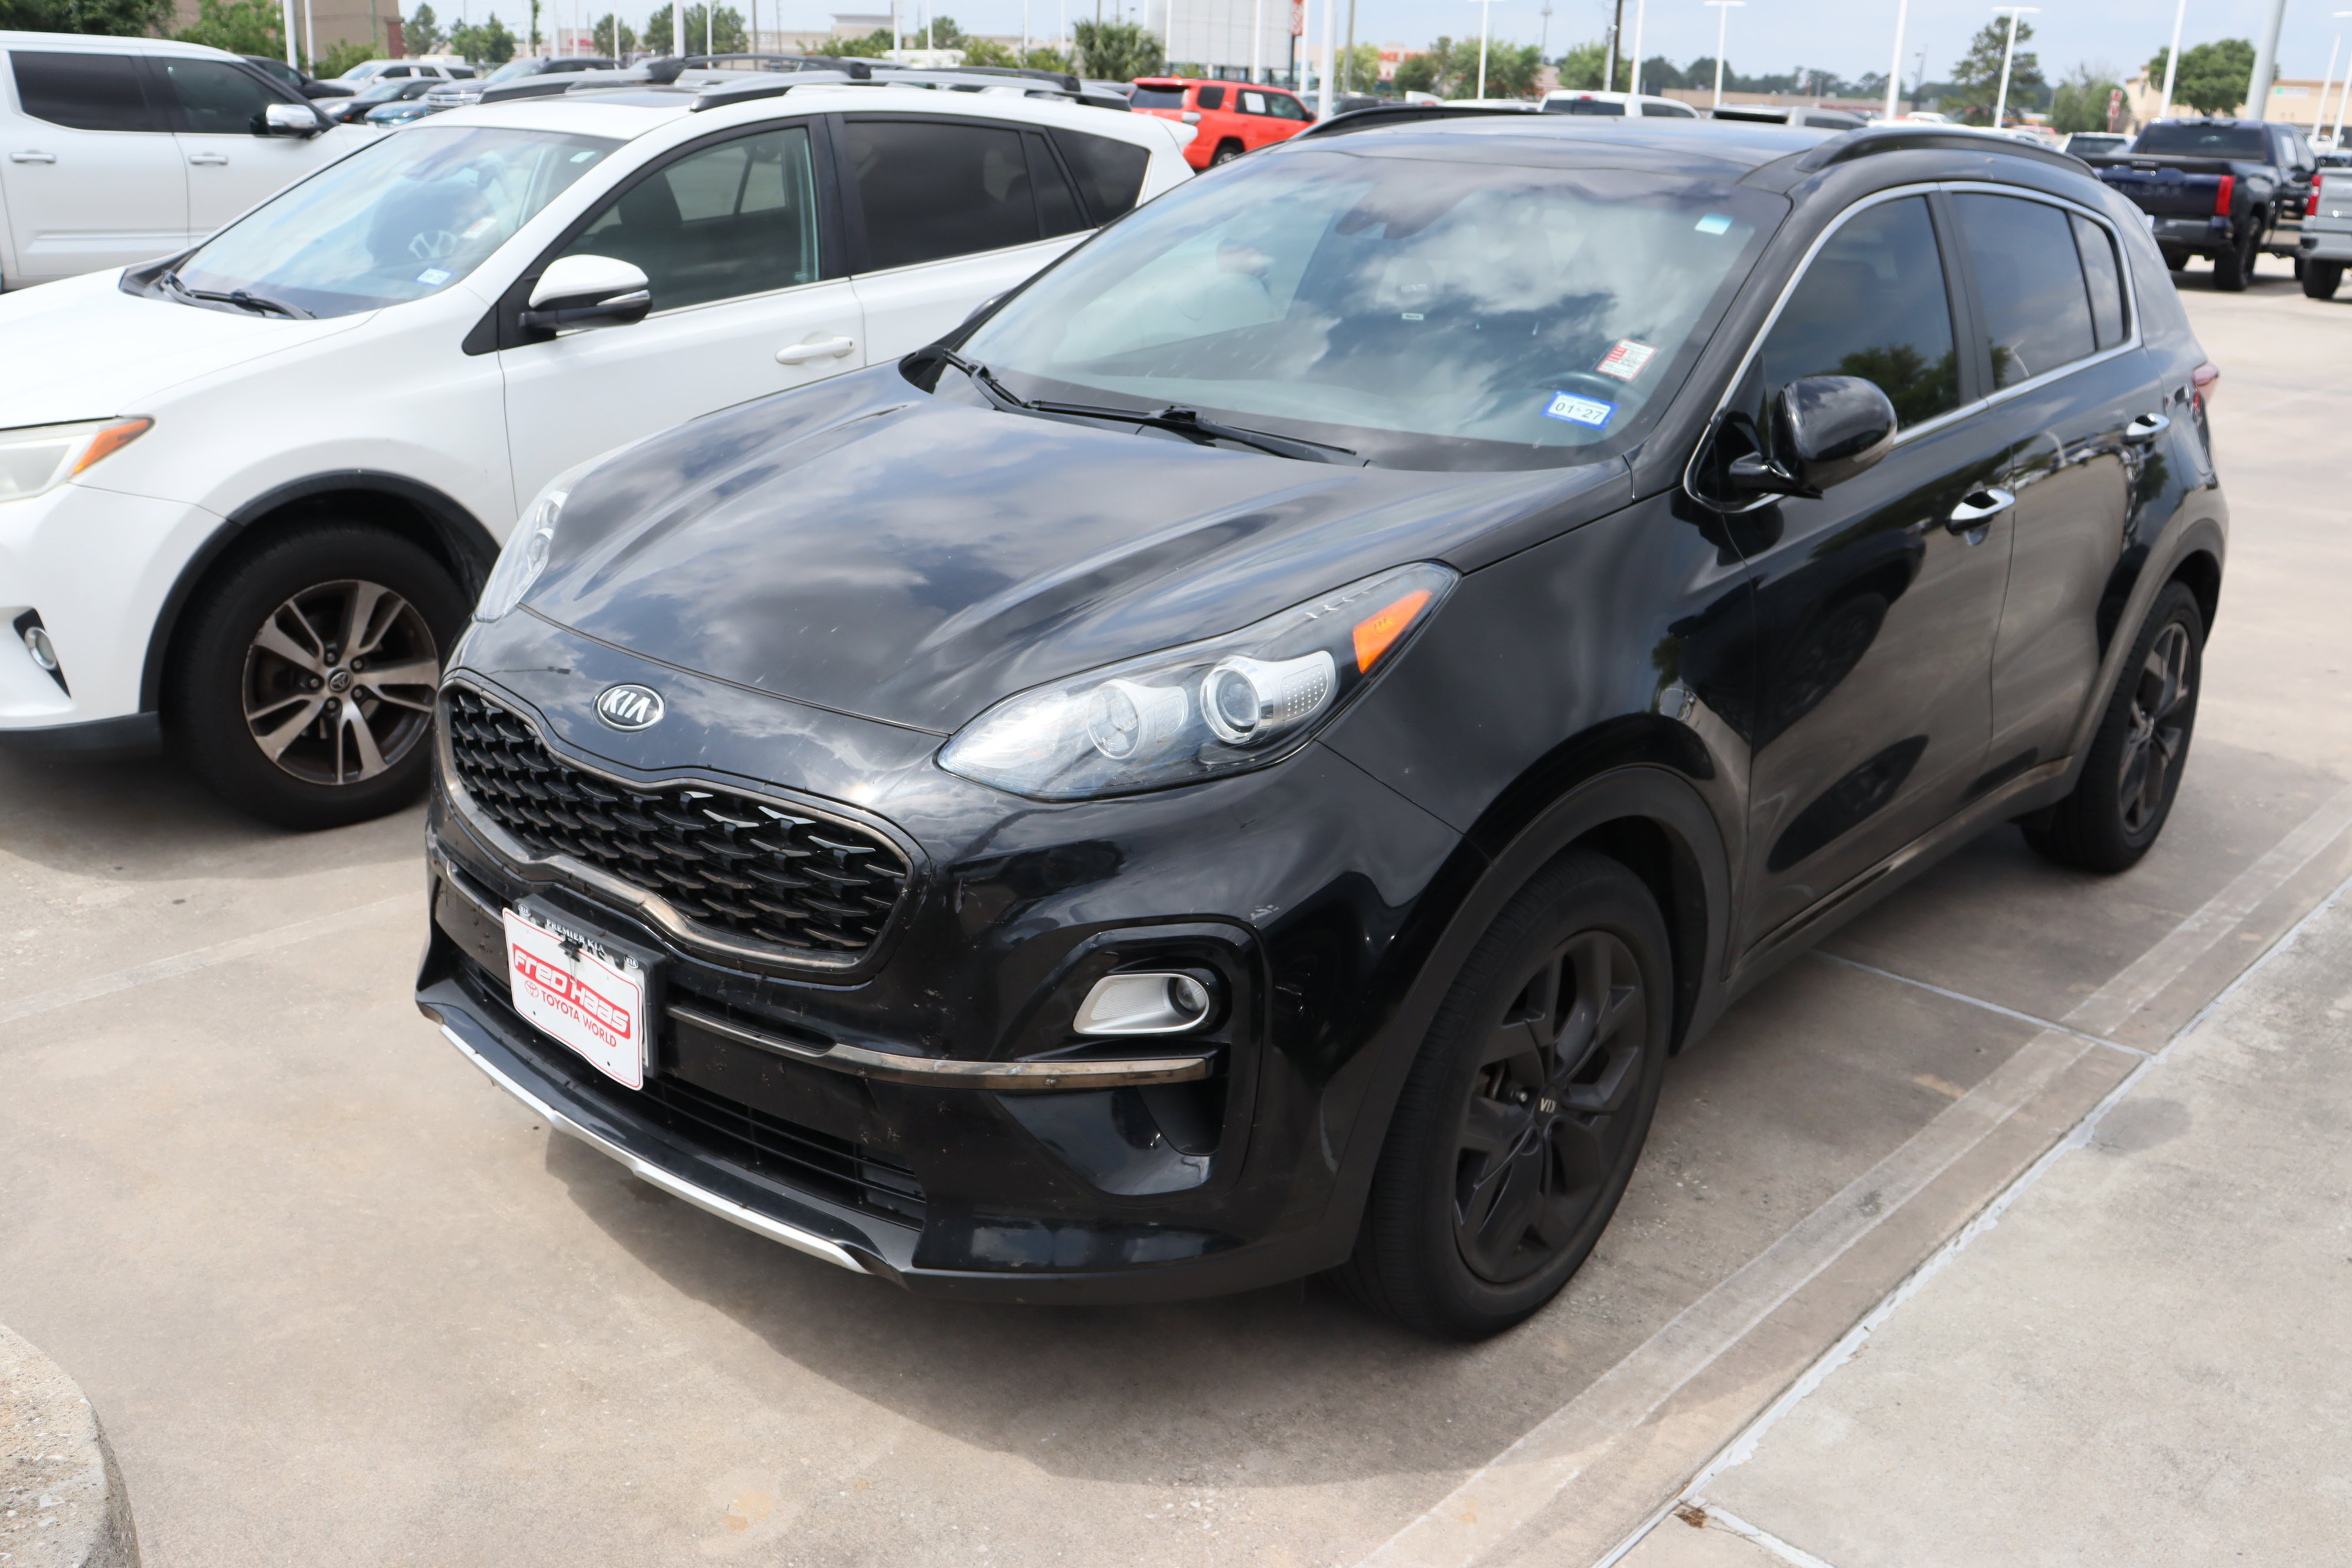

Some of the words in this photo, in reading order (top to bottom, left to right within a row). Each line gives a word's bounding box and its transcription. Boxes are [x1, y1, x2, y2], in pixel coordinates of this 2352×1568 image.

[1556, 402, 1574, 414] 01
[1582, 409, 1604, 420] 27
[602, 688, 651, 723] KIA
[546, 918, 585, 945] PREMIER
[587, 939, 606, 954] KIA
[541, 989, 580, 1023] TOYOTA
[583, 1014, 617, 1047] WORLD
